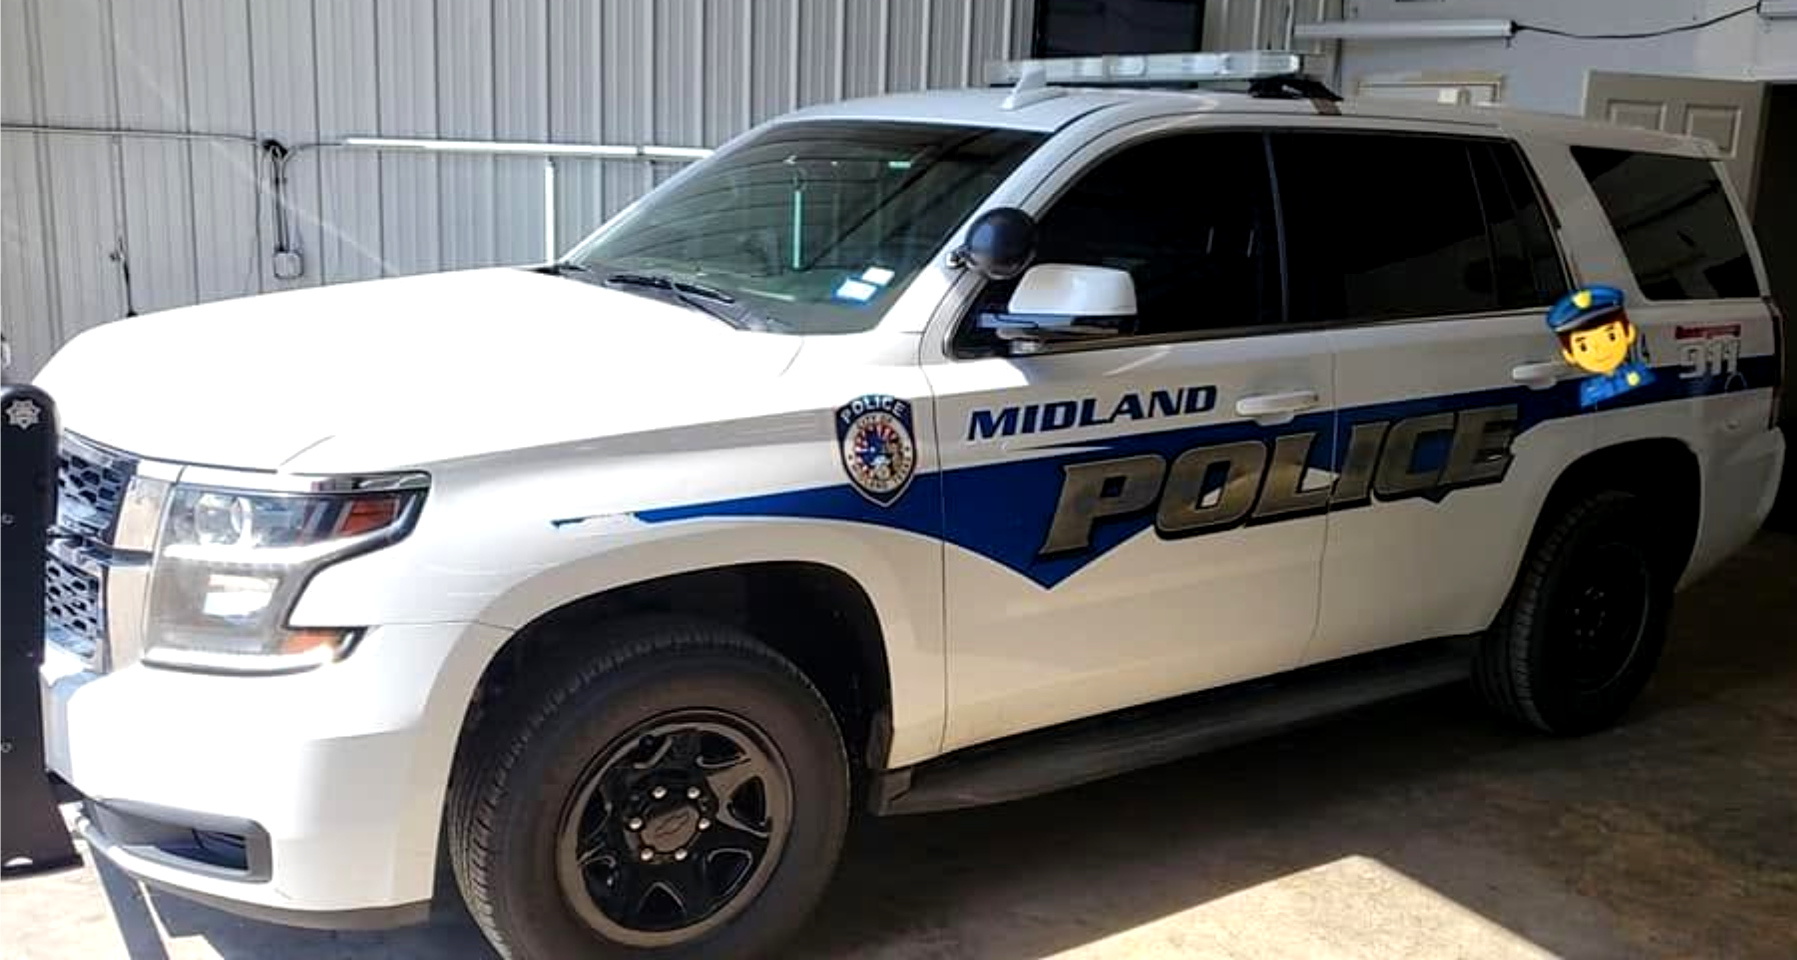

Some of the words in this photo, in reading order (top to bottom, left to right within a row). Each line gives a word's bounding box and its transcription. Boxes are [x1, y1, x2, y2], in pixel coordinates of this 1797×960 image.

[1679, 339, 1740, 379] 911
[840, 396, 906, 424] POLICE
[967, 385, 1217, 441] MIDLAND
[1037, 403, 1520, 560] POLICE
